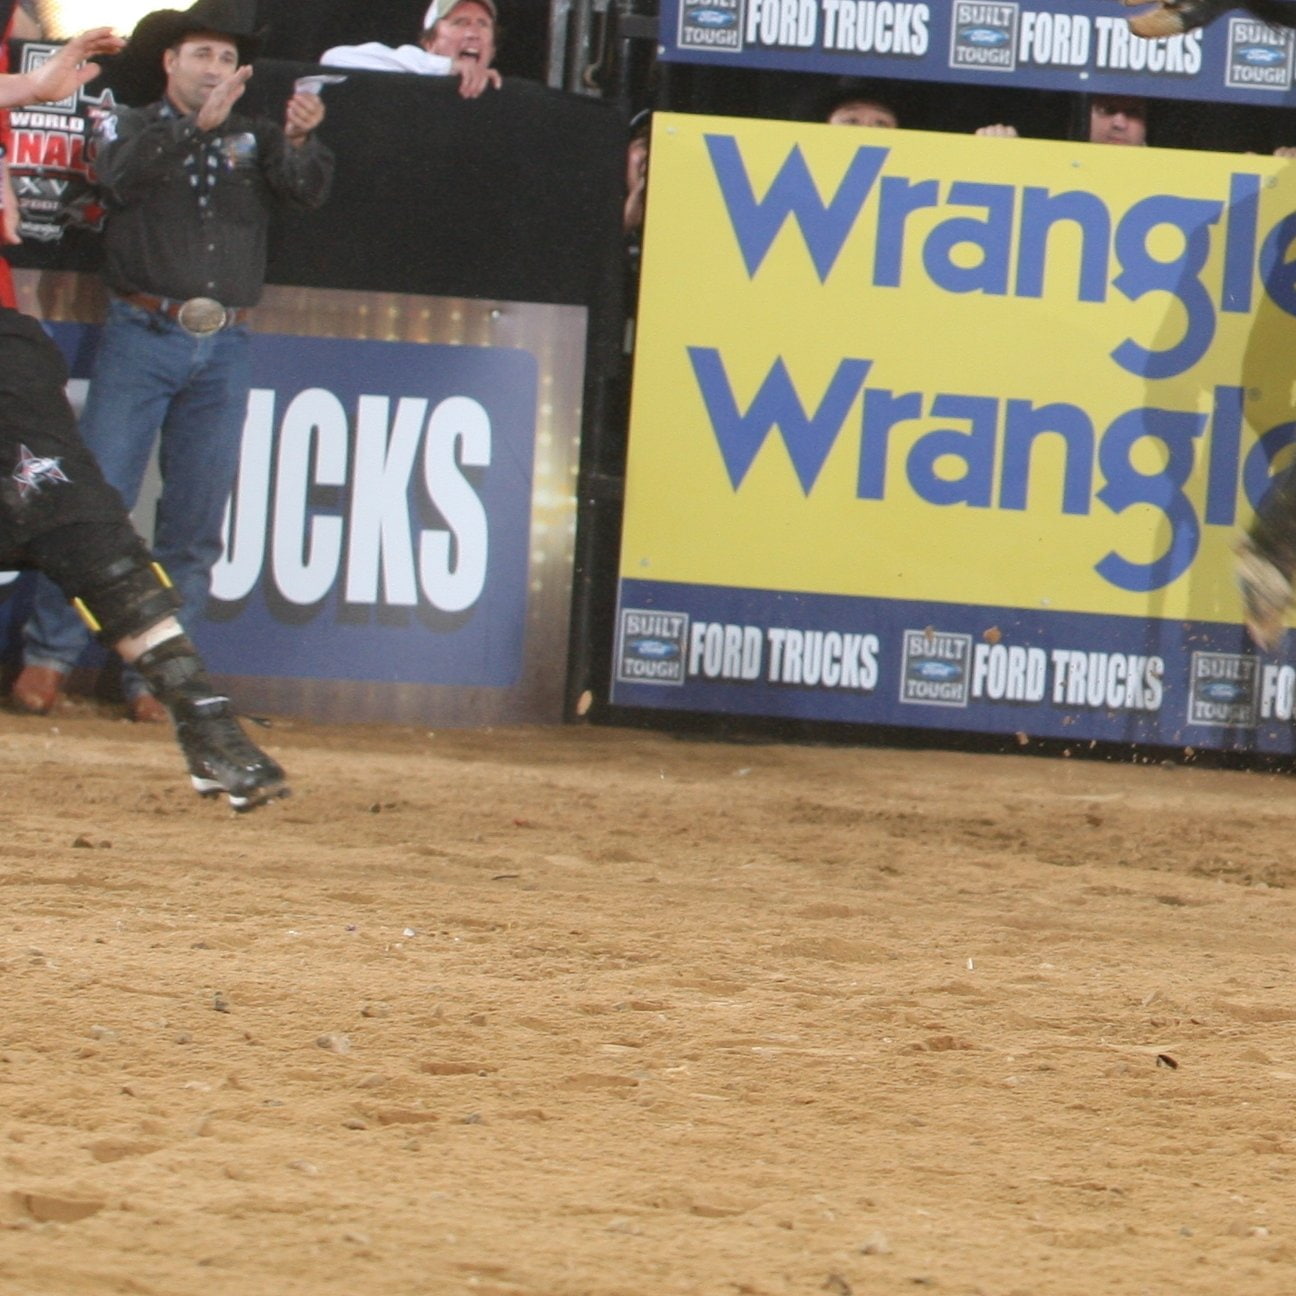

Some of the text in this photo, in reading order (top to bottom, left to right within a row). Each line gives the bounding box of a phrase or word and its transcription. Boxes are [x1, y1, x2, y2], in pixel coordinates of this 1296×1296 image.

[957, 4, 1013, 27] BUILT
[682, 26, 739, 46] TOUGH
[1019, 11, 1203, 74] FORD TRUCKS
[955, 45, 1011, 66] TOUGH
[1231, 63, 1287, 84] TOUGH
[10, 110, 85, 133] WORLD
[627, 614, 684, 638] BUILT
[688, 621, 880, 690] FORD TRUCKS
[909, 635, 967, 660] BUILT
[624, 657, 681, 679] TOUGH
[971, 643, 1165, 711] FORD TRUCKS
[907, 679, 964, 701] TOUGH
